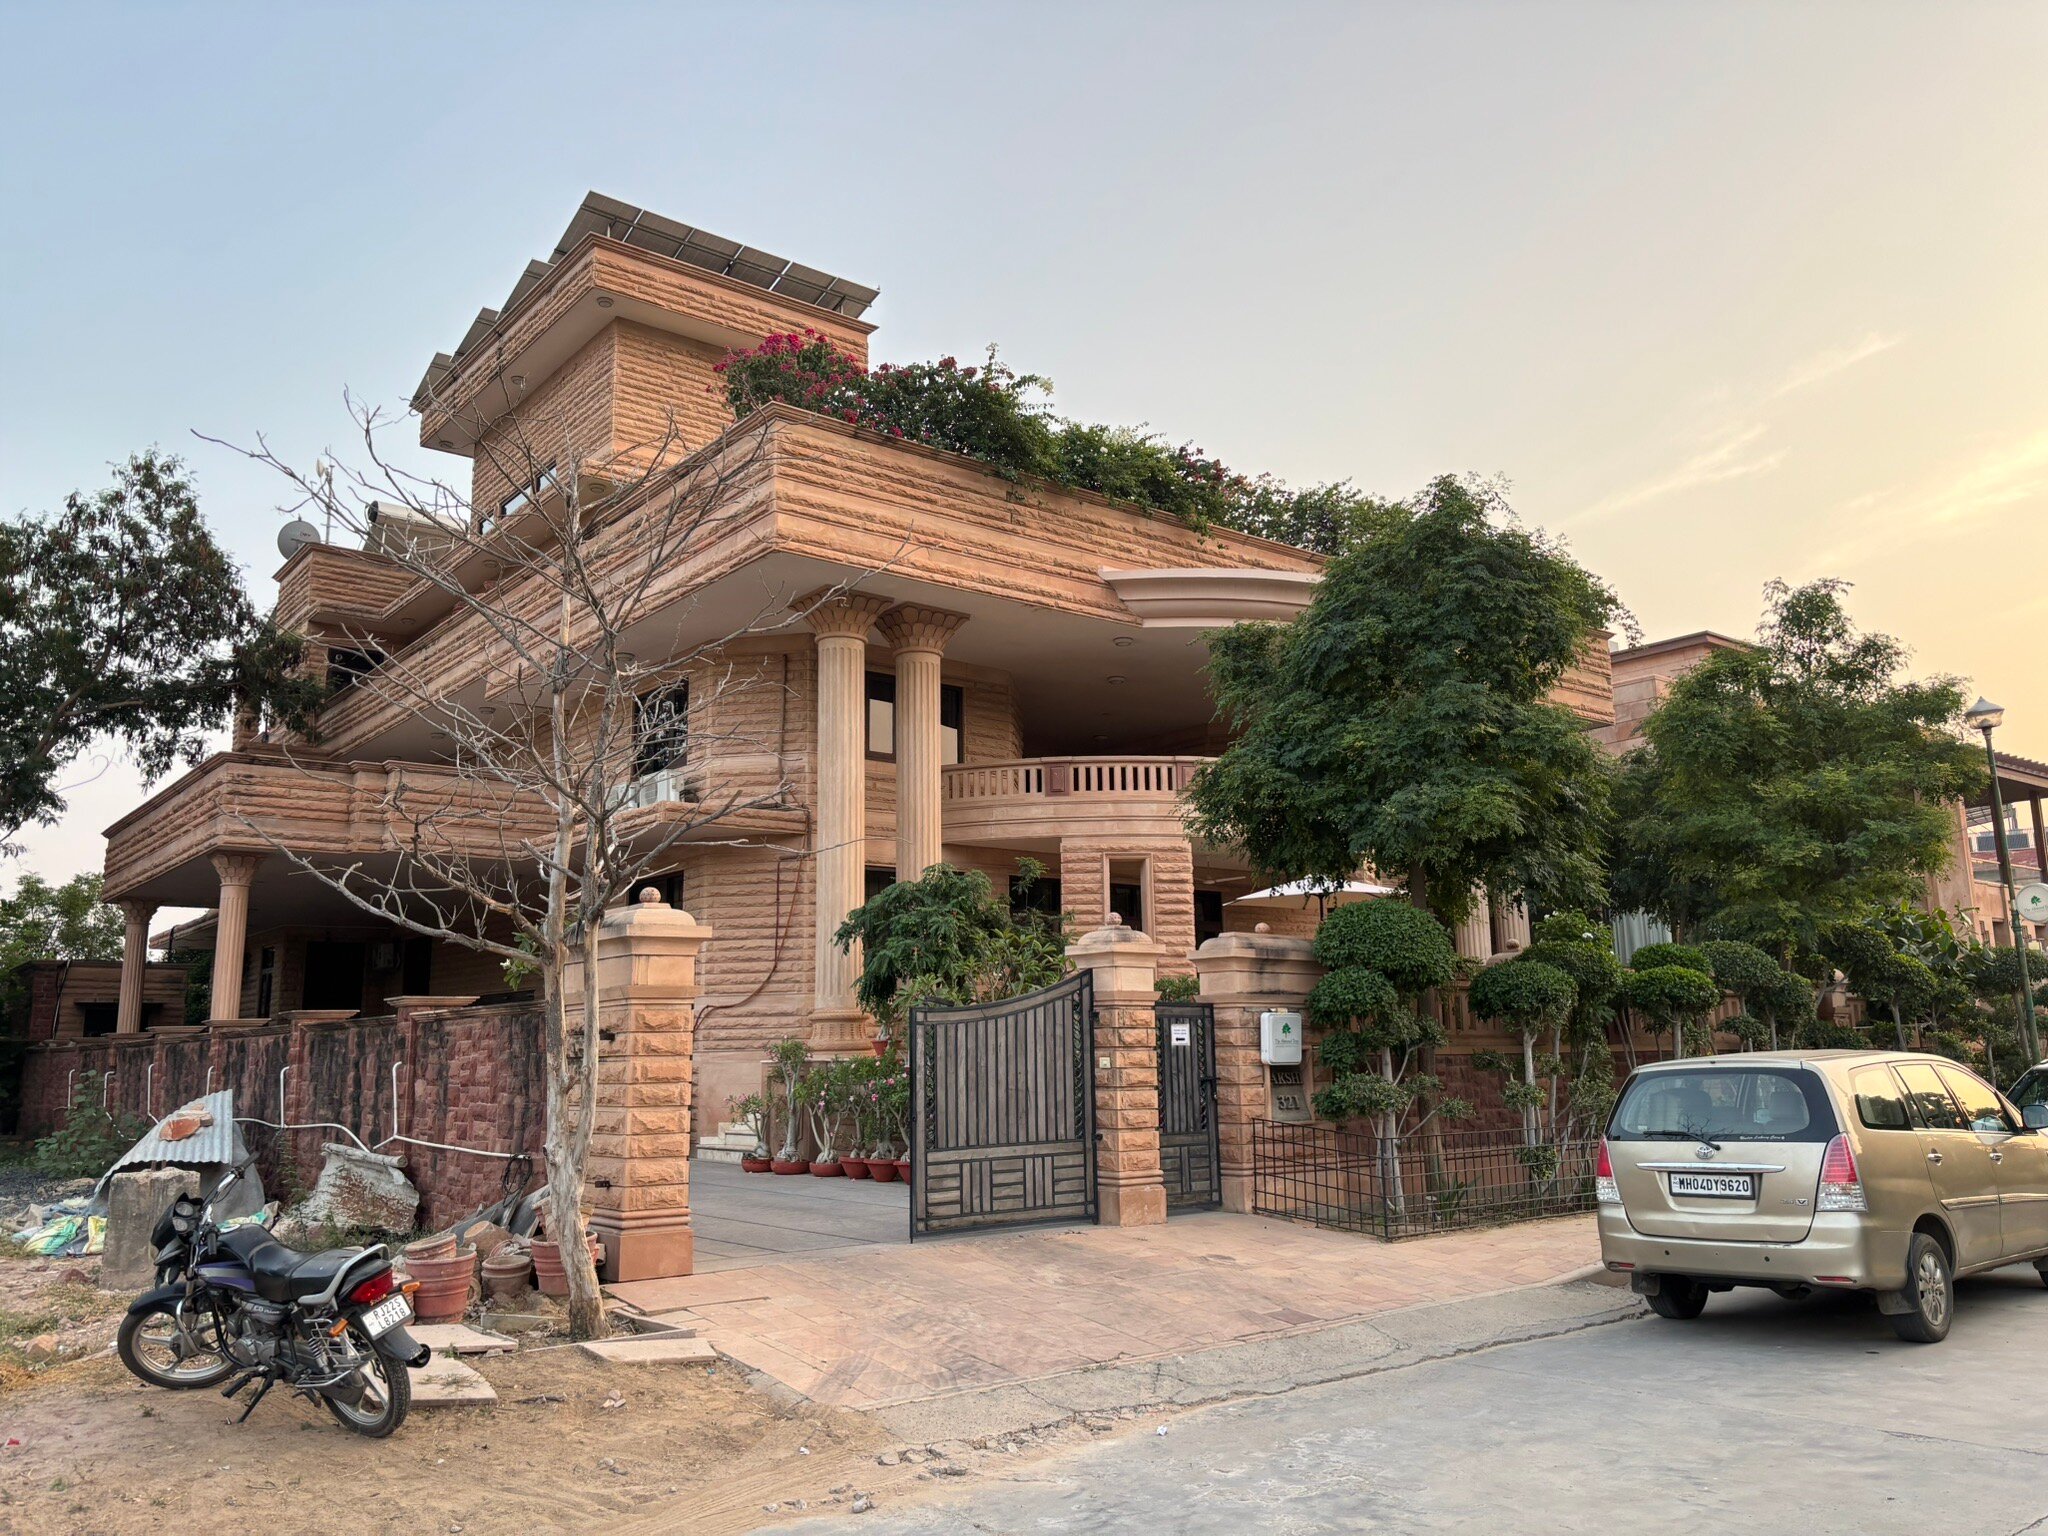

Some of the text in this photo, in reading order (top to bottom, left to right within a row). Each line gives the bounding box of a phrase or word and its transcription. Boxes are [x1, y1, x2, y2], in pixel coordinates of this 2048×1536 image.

[1277, 1094, 1300, 1109] 321
[1679, 1177, 1749, 1192] MH04DY9620
[372, 1298, 401, 1320] RJ22S
[377, 1308, 407, 1330] L8218
